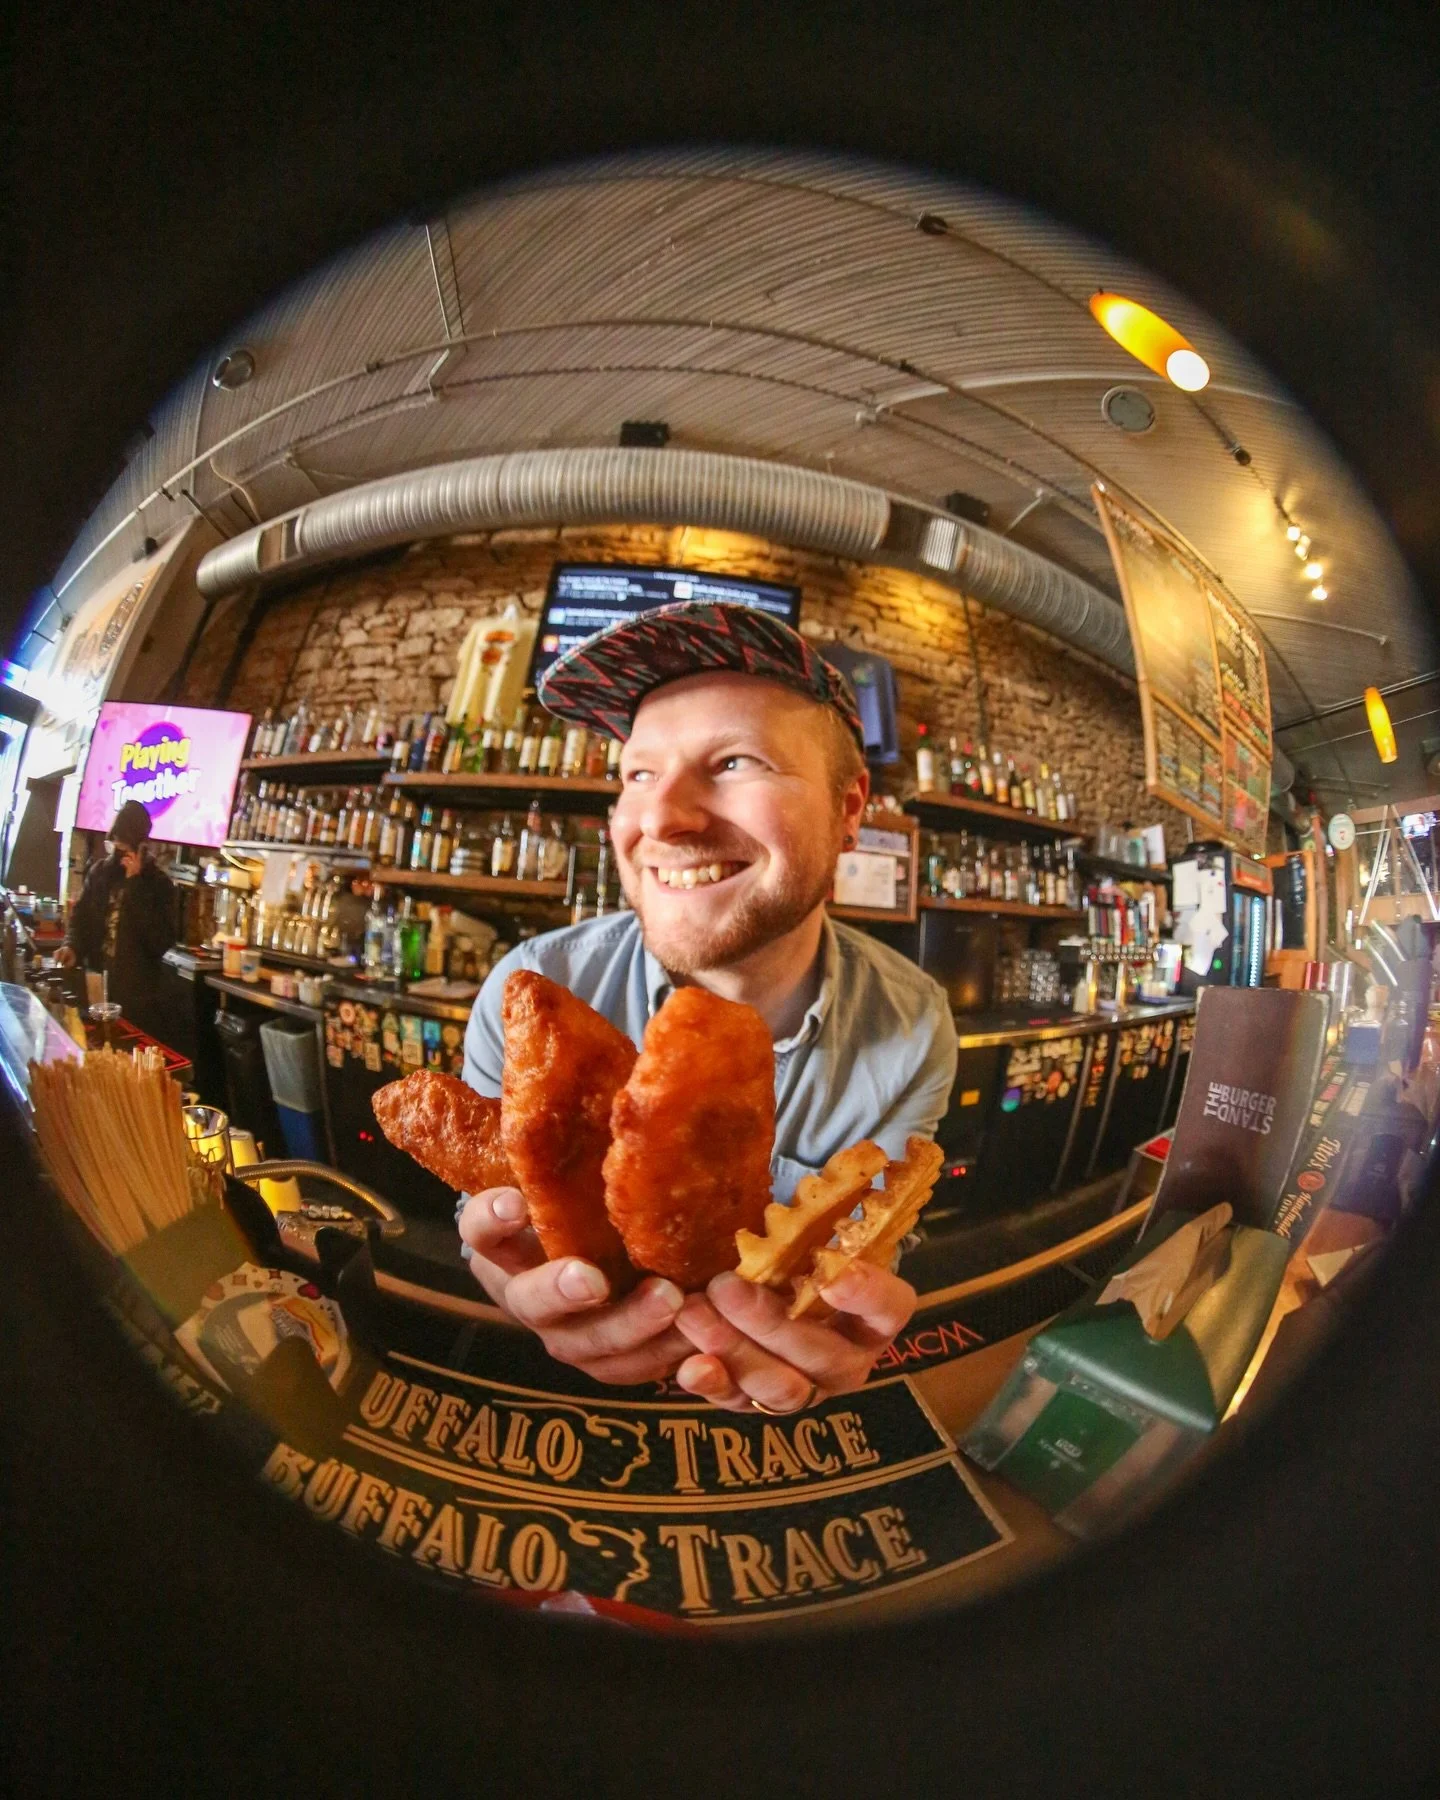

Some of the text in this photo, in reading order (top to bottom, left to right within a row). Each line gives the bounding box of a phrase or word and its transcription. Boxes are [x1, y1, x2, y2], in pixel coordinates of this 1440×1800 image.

[120, 736, 191, 772] Playing
[1203, 1081, 1223, 1117] THE
[1220, 1084, 1277, 1116] BURGER
[1217, 1103, 1274, 1135] STAND
[1306, 1136, 1341, 1171] Tito's
[872, 1320, 985, 1371] WOME
[358, 1371, 881, 1496] UFFALO TRACE
[261, 1442, 928, 1616] BUFFALO TRACE
